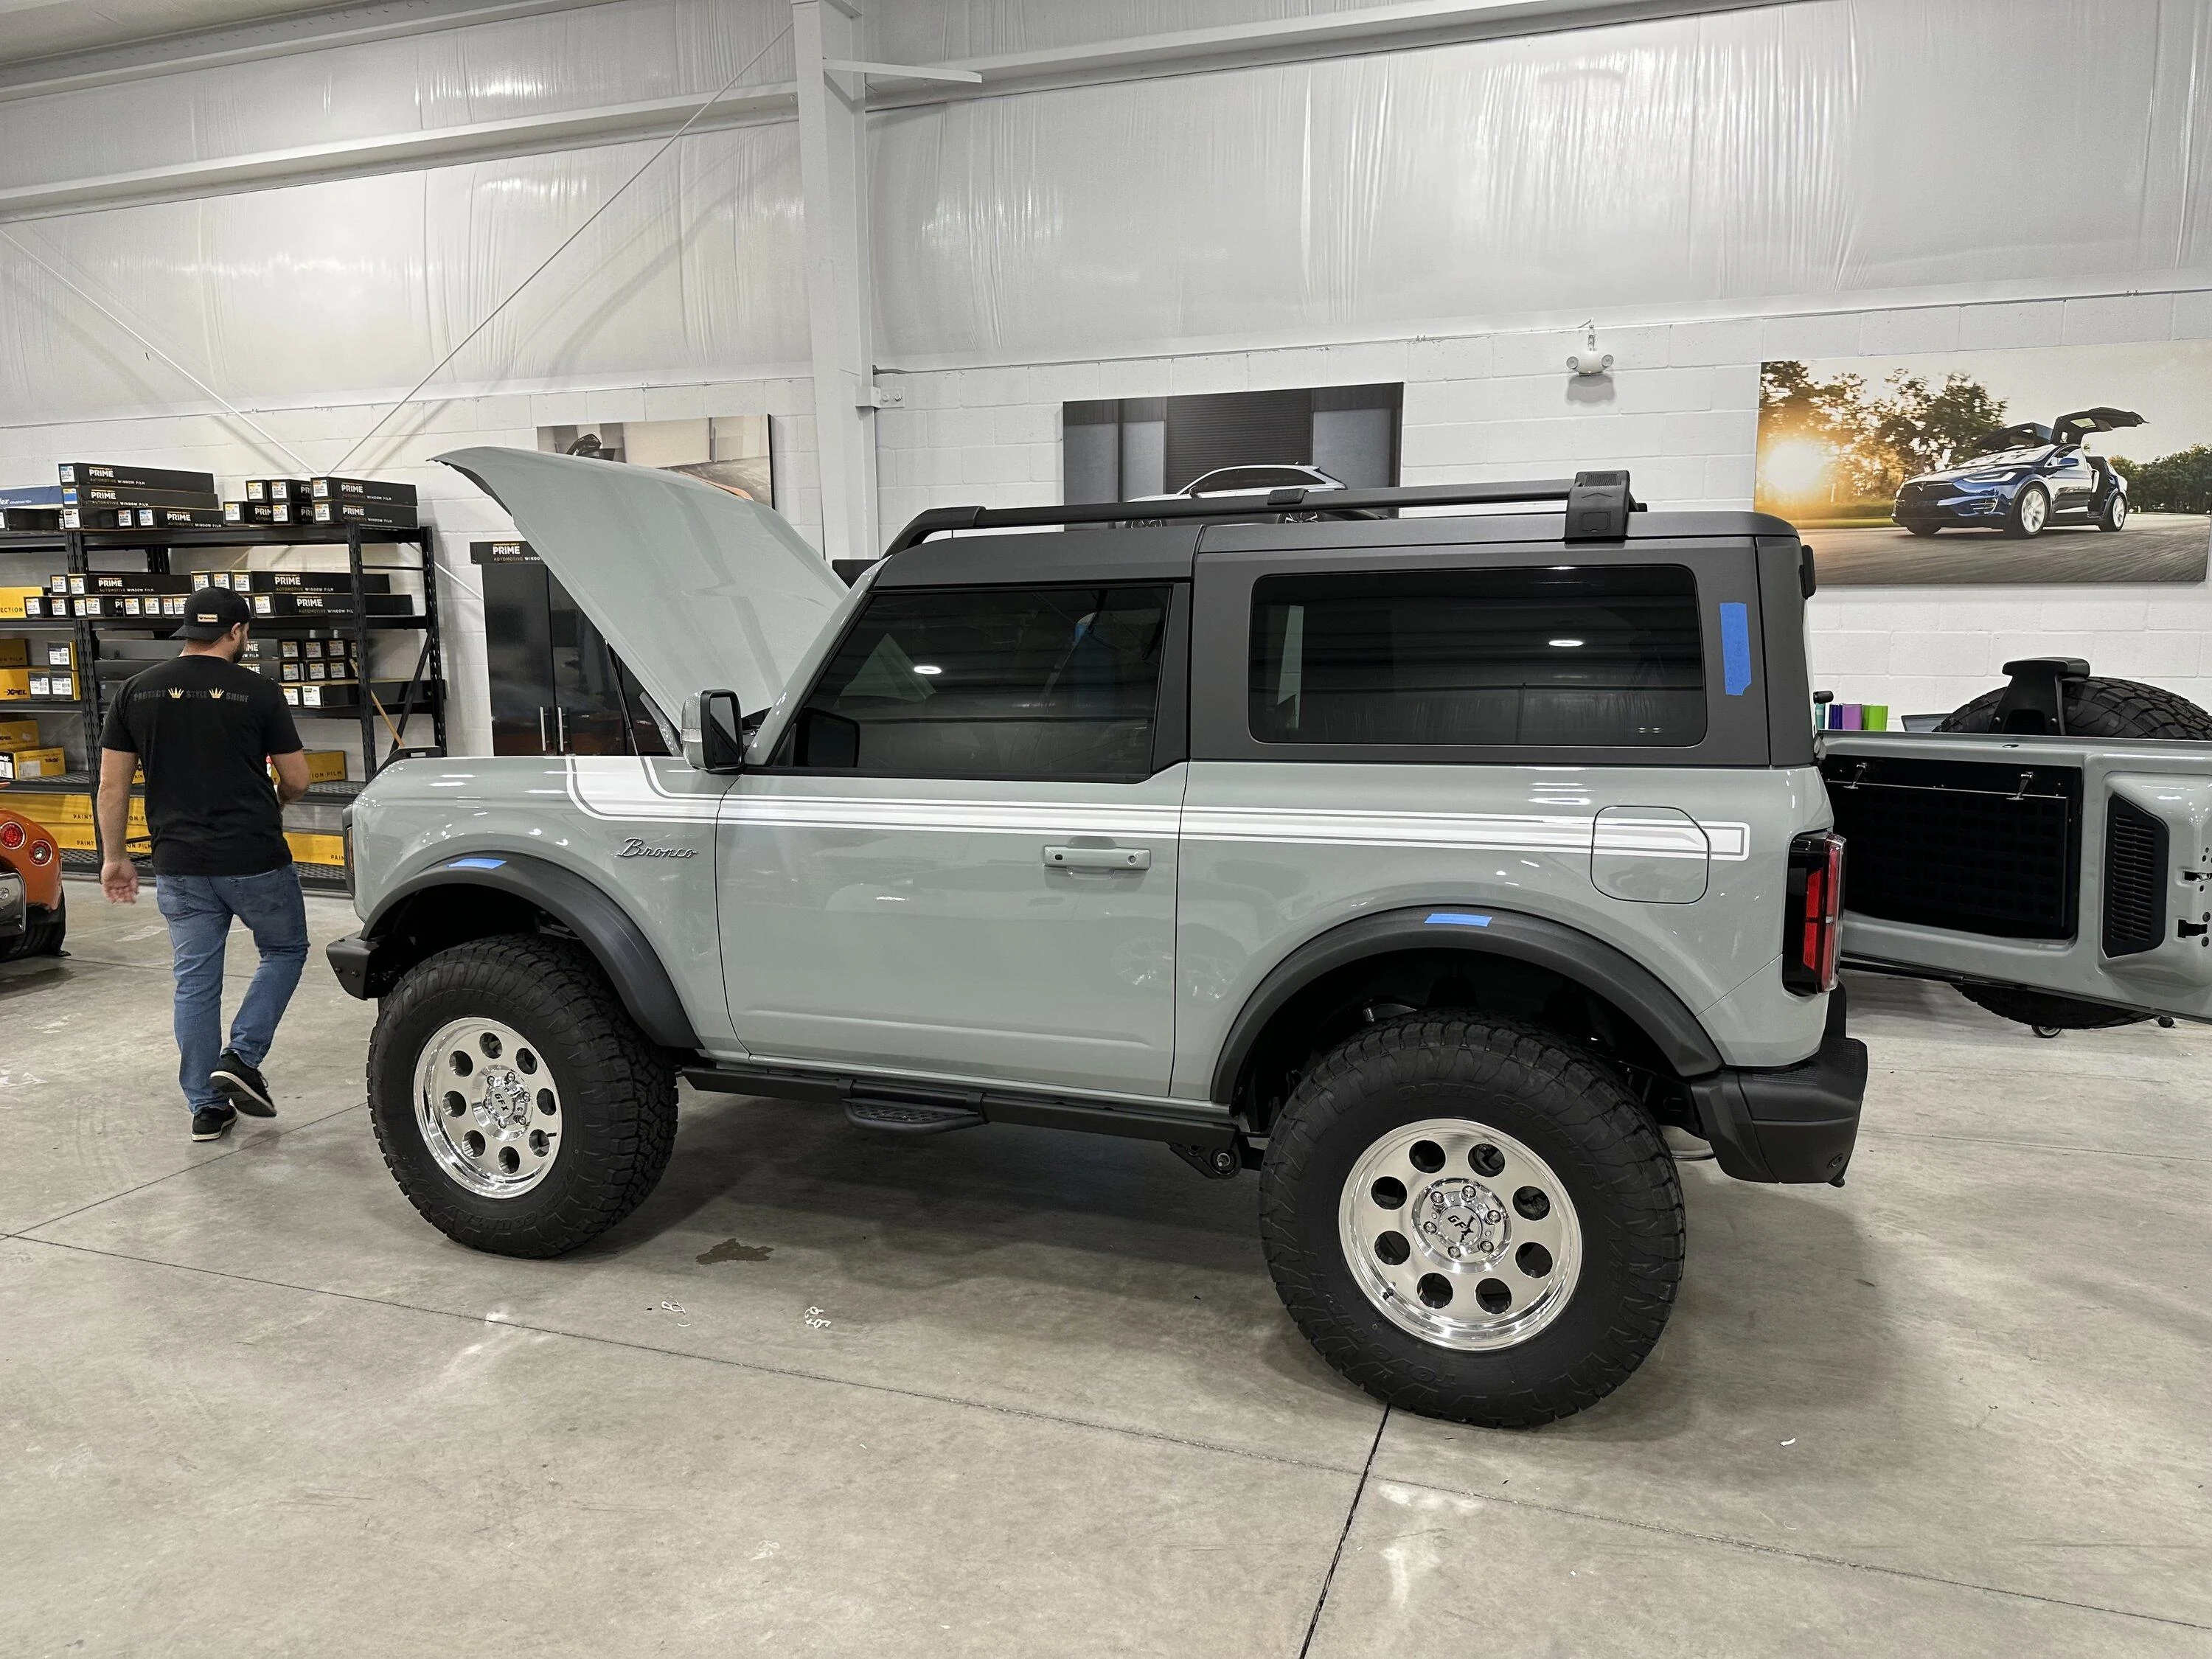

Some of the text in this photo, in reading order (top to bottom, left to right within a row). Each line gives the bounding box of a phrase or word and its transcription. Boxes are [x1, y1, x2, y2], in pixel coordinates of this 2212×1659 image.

[88, 469, 114, 478] PRIME
[341, 484, 364, 493] PRIME
[91, 492, 116, 500] PRIME
[342, 507, 364, 516] PRIME
[167, 513, 191, 521] PRIME
[493, 546, 521, 555] PRIME
[274, 577, 301, 585] PRIME
[296, 599, 323, 607] PRIME
[186, 690, 208, 698] STYLE
[226, 692, 250, 703] SHINE
[616, 837, 698, 858] Bronco
[495, 1093, 509, 1111] GFX
[1447, 1214, 1476, 1242] GFX
